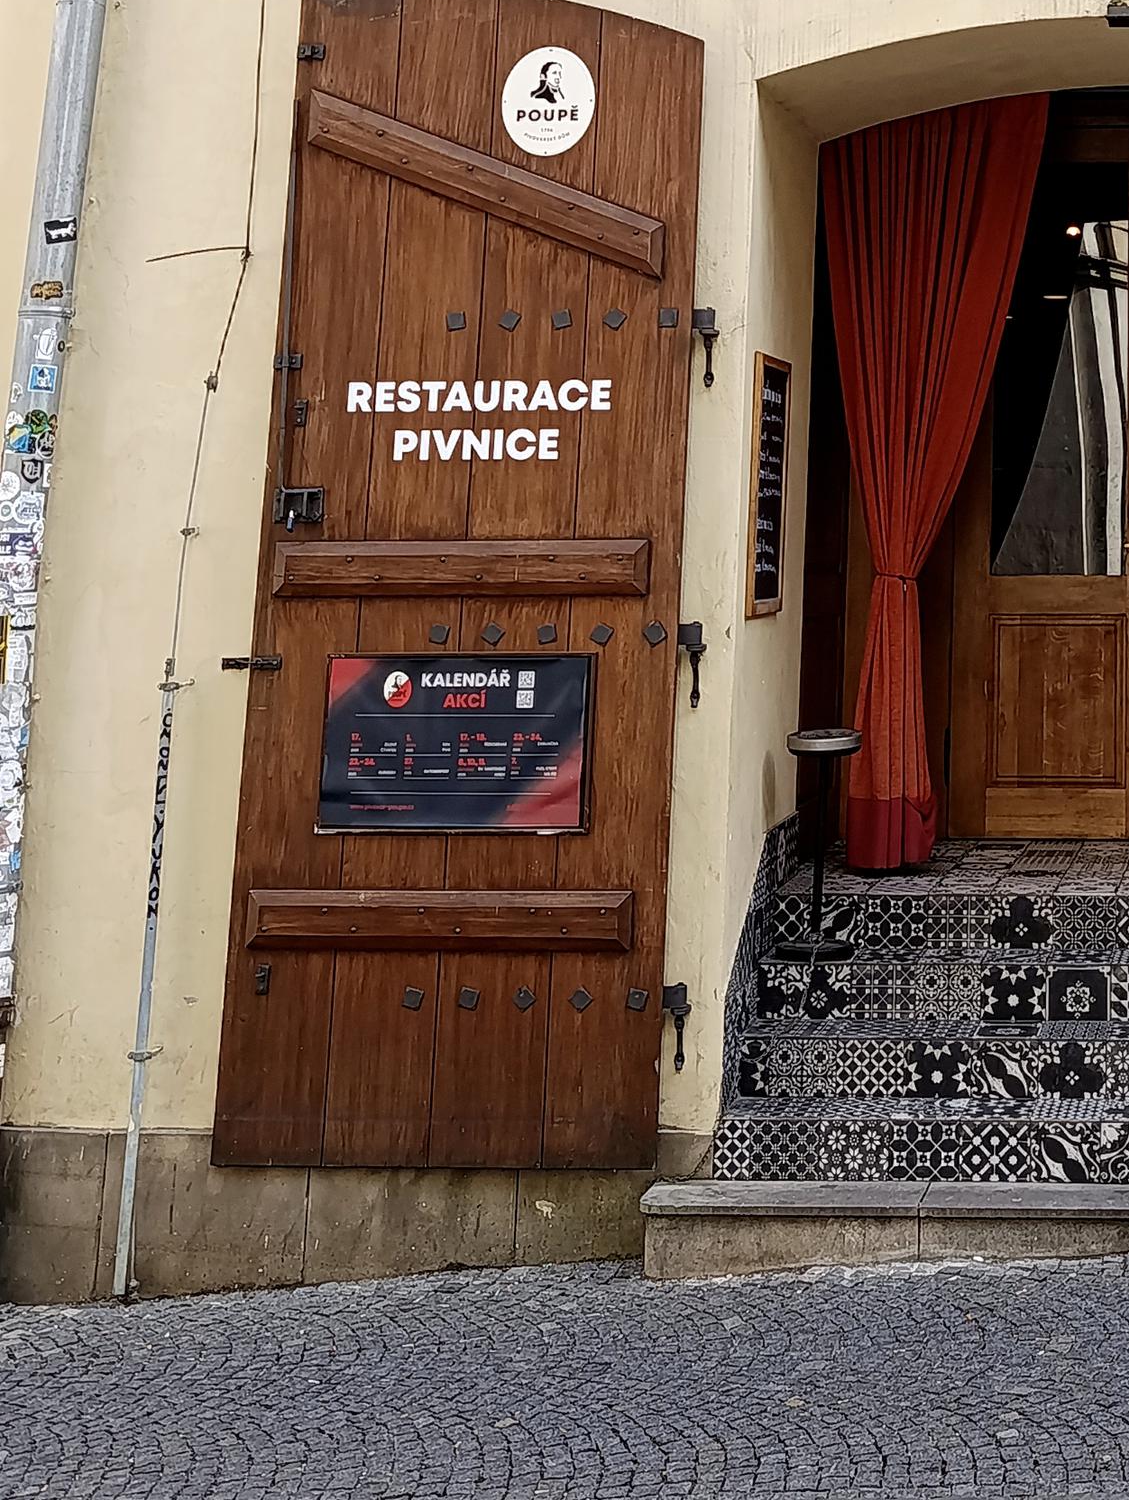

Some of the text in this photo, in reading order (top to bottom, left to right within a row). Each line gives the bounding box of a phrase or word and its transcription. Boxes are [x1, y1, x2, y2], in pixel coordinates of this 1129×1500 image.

[516, 105, 579, 122] POUPĚ
[347, 379, 612, 413] RESTAURACE
[392, 428, 560, 461] PIVNICE
[421, 669, 512, 688] KALENDÁŘ
[443, 689, 487, 709] AKCÍ
